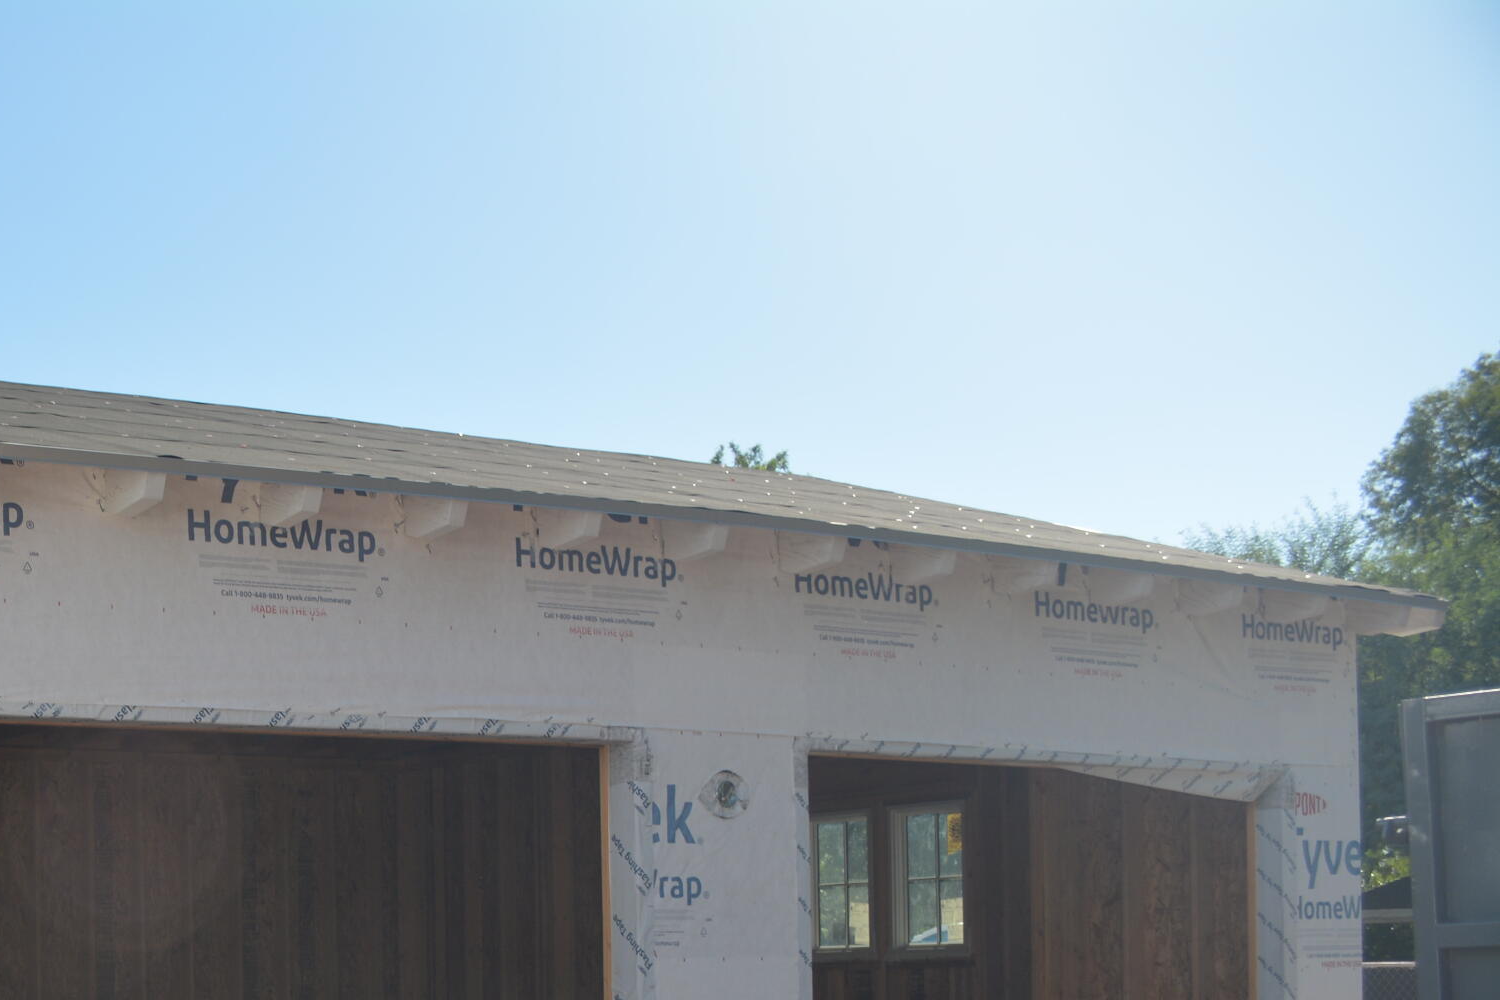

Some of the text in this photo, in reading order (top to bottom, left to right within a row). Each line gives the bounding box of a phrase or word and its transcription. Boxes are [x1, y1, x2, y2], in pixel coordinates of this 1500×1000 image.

[188, 508, 376, 562] HomeWrap
[516, 537, 676, 587] HomeWrap
[794, 572, 932, 612] HomeWrap
[1242, 613, 1343, 651] HomeWrap
[612, 833, 624, 857] Tape
[613, 913, 652, 970] Flashing Tape
